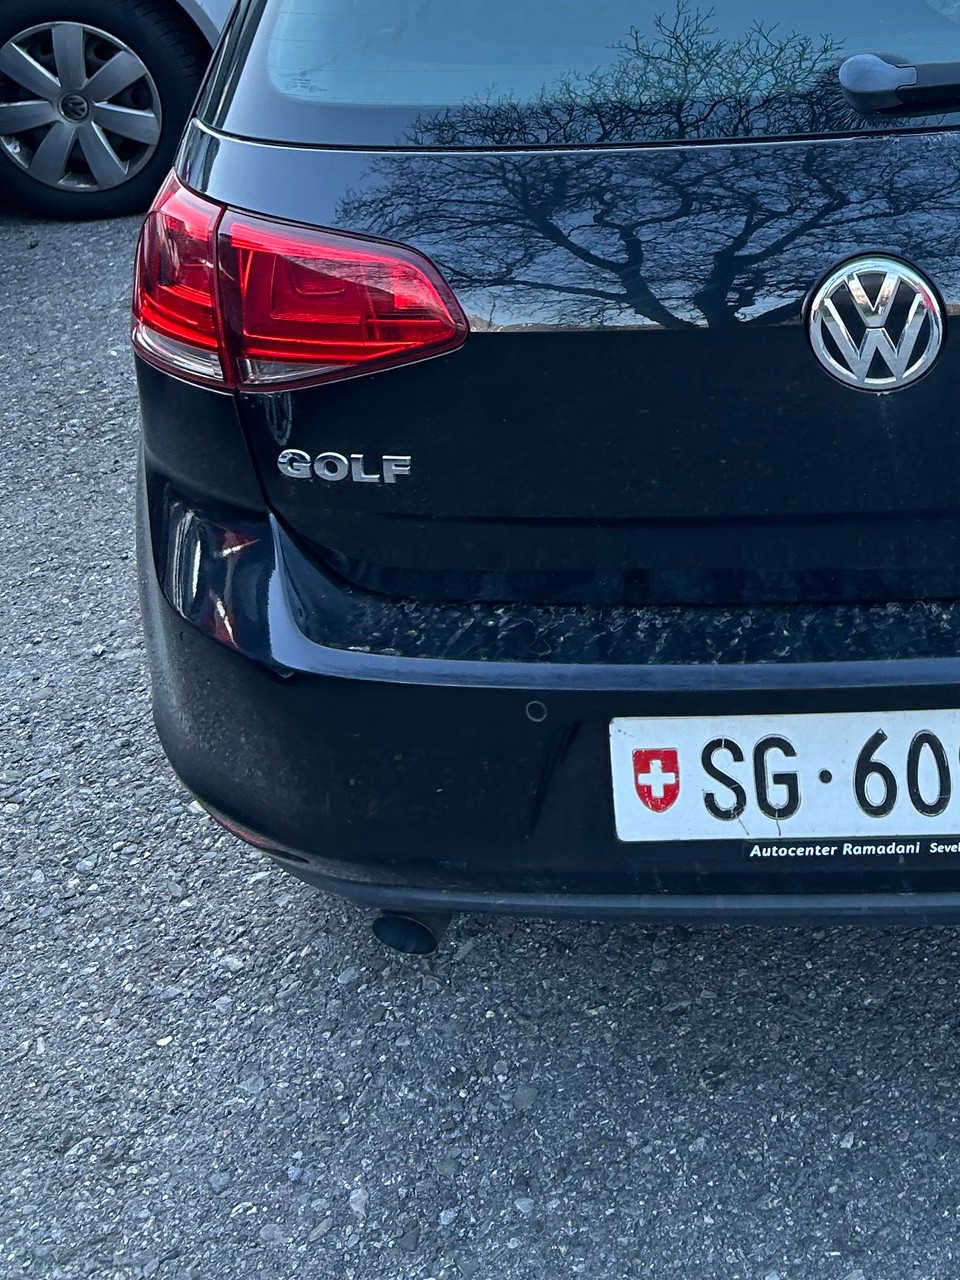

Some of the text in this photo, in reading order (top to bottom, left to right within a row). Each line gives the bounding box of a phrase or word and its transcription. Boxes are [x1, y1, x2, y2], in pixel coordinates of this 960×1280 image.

[811, 261, 940, 388] VW
[277, 448, 412, 484] GOLF
[749, 844, 838, 857] Autocenter
[842, 841, 921, 856] Ramadani
